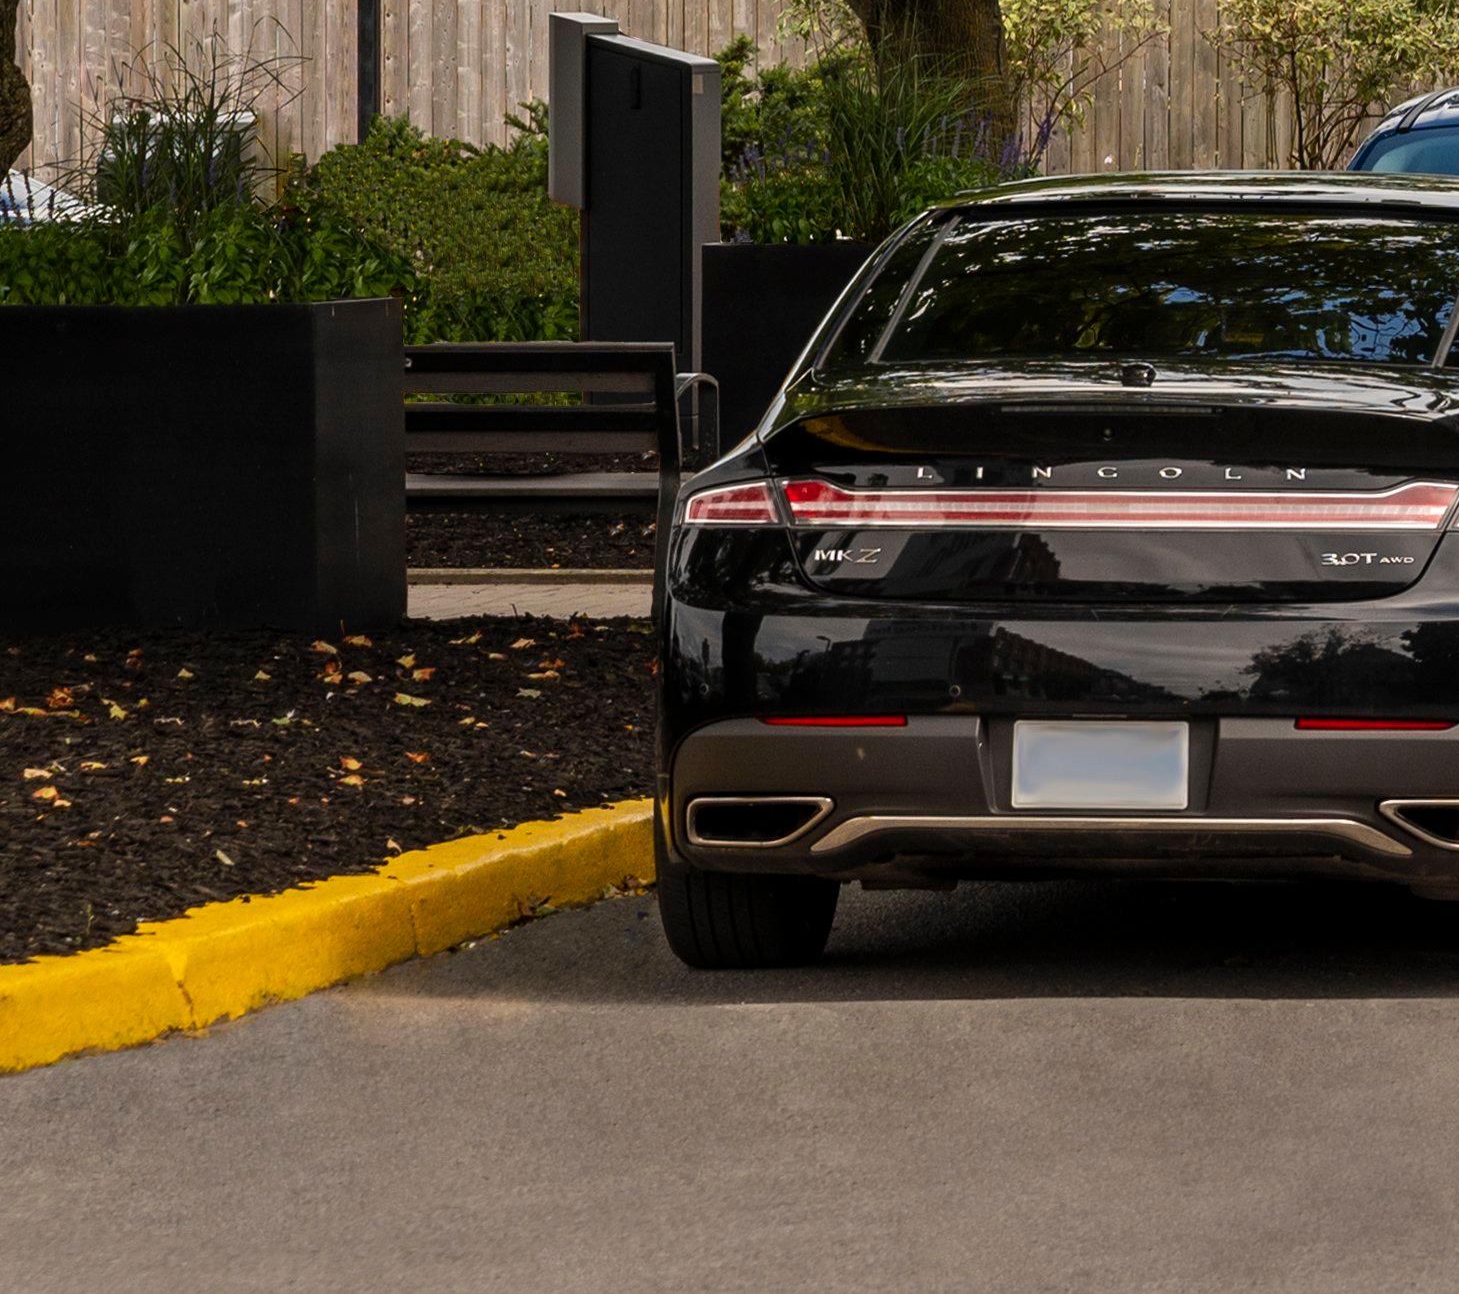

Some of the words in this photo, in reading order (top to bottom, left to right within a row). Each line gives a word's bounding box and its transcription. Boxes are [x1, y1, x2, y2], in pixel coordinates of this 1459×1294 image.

[916, 465, 1307, 480] LINCOLN
[813, 547, 882, 564] MKZ
[1379, 556, 1415, 564] AWD
